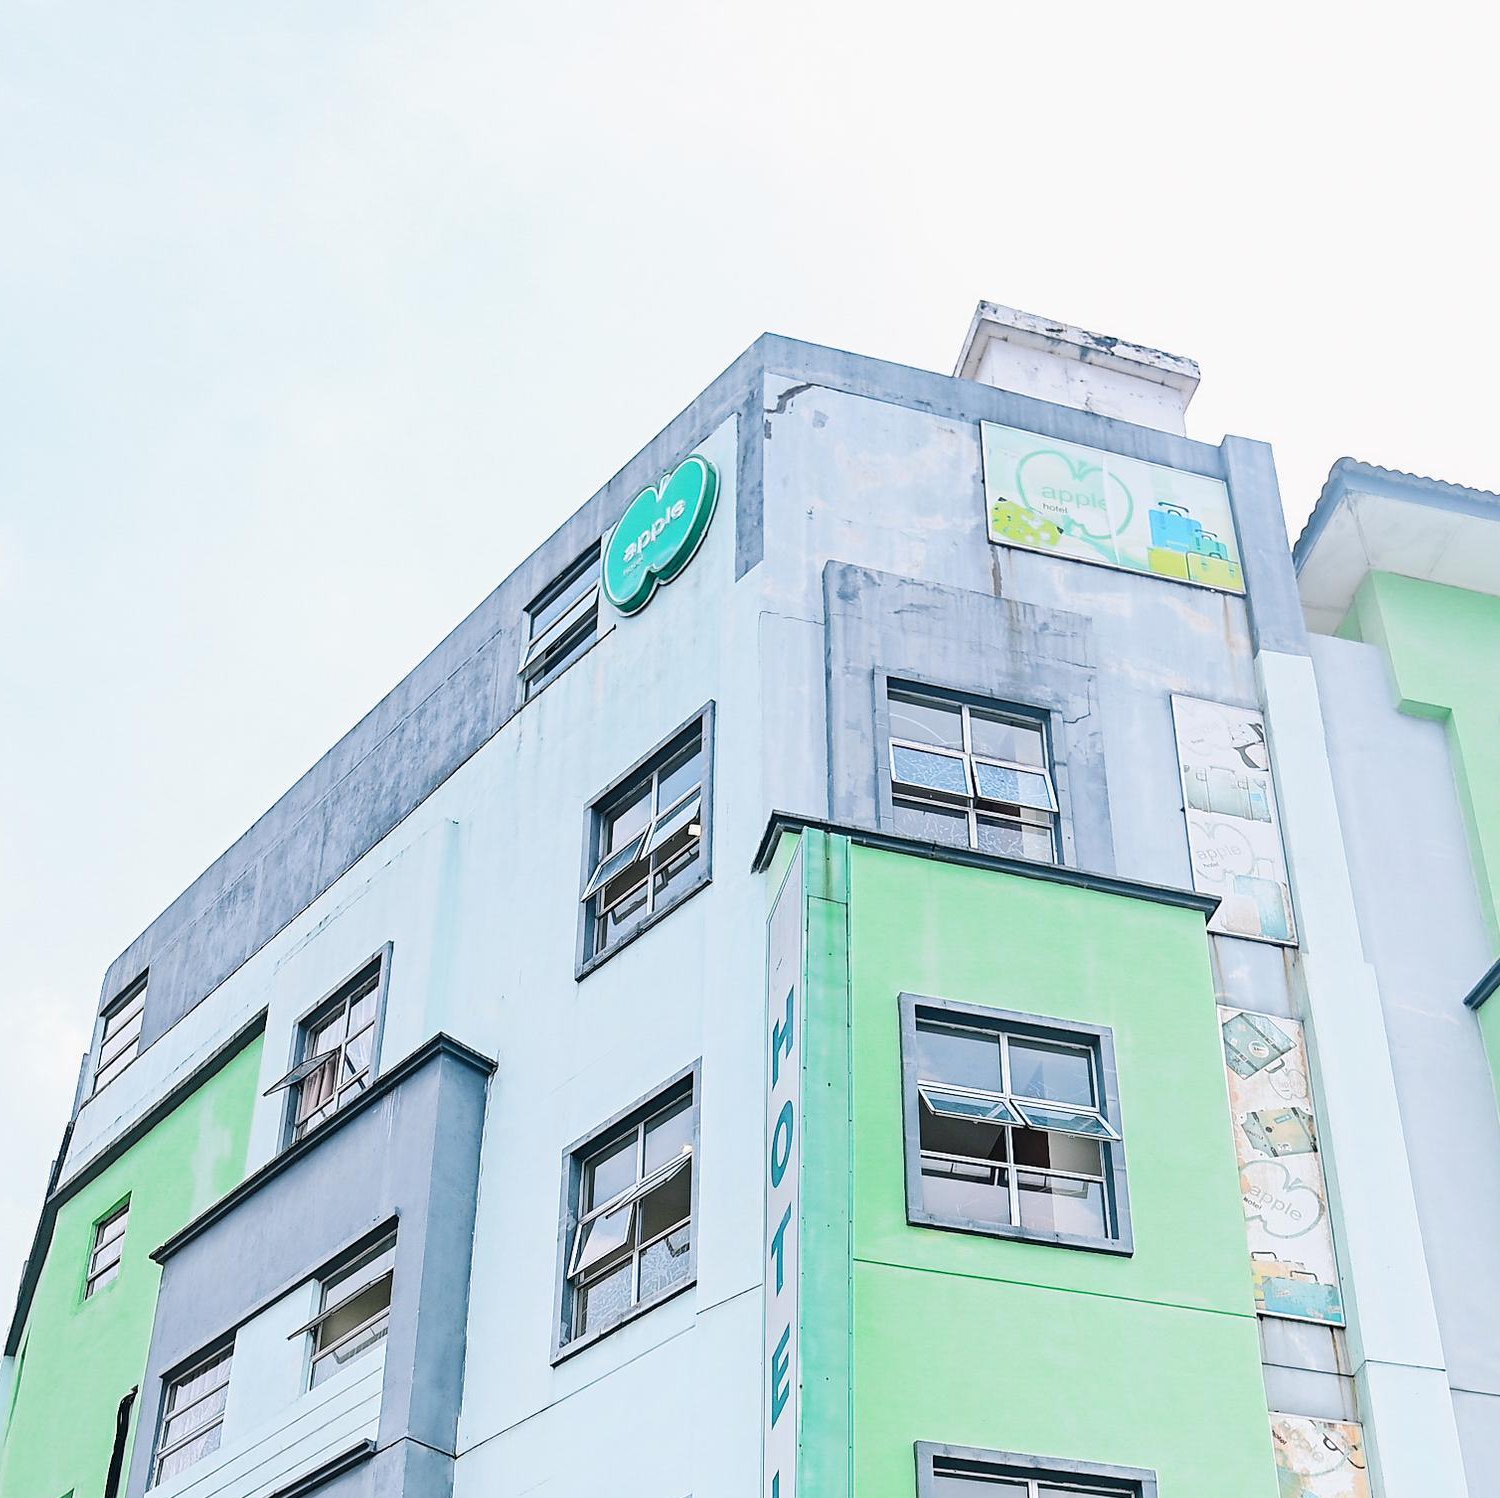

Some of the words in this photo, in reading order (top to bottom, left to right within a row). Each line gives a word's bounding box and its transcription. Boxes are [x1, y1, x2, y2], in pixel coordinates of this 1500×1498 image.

[1042, 502, 1068, 515] hotel
[623, 500, 686, 562] apple
[1251, 1185, 1303, 1221] apple
